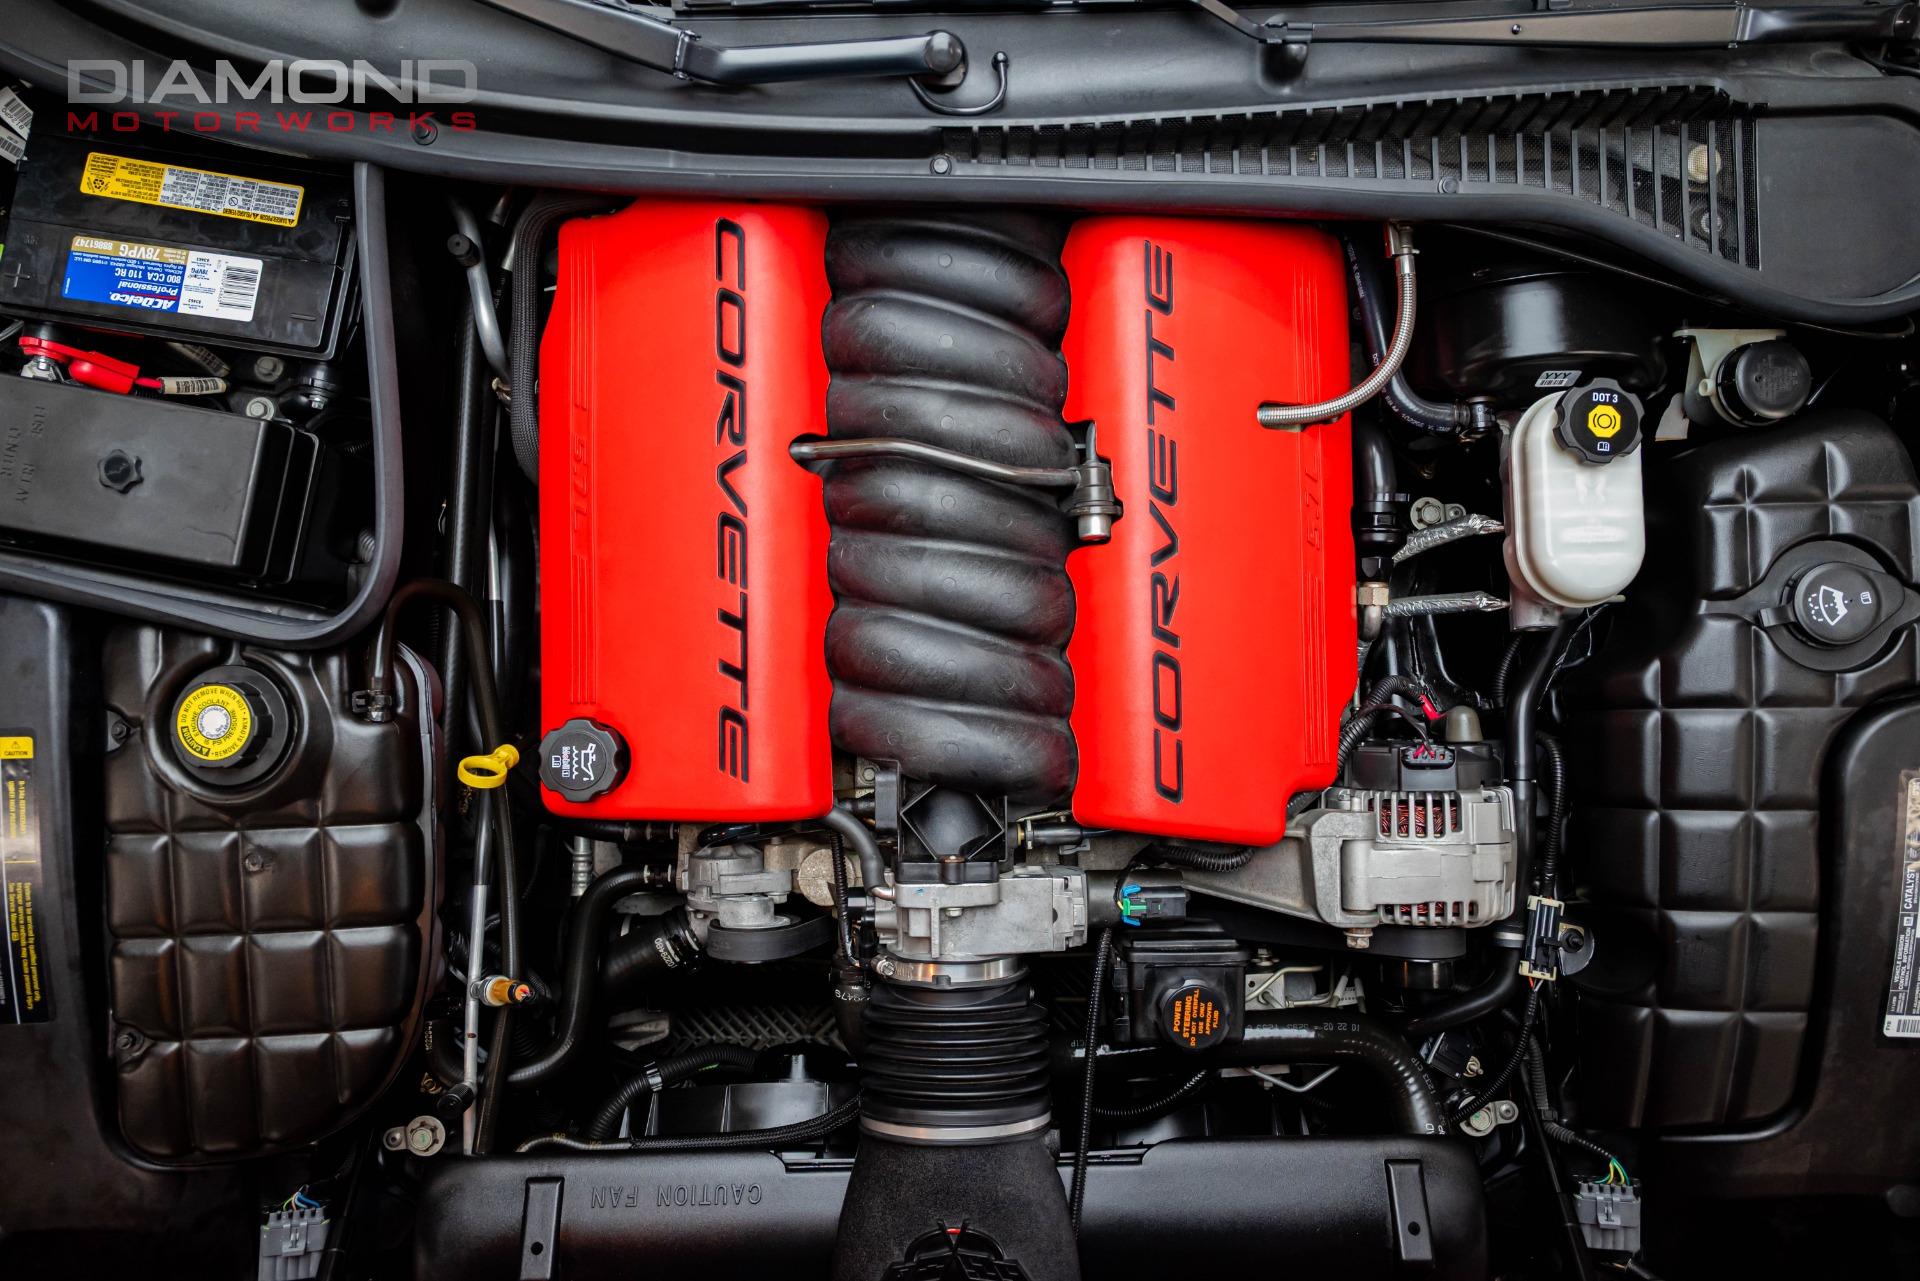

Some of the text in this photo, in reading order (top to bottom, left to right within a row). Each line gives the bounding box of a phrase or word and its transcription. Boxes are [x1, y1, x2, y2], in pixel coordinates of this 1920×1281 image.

[119, 244, 161, 260] 78VPG
[114, 267, 127, 278] RC
[128, 269, 142, 280] 110
[147, 271, 165, 283] CCA
[166, 274, 182, 284] 800
[118, 280, 179, 295] Professional
[109, 291, 176, 310] ACDelco
[1592, 392, 1618, 403] DOT 3
[716, 217, 749, 785] CORVETTE
[1143, 239, 1185, 805] CORVETTE
[181, 714, 188, 722] DO
[193, 688, 218, 700] REMOVE
[220, 689, 236, 700] WHEN
[236, 698, 246, 712] HOT
[198, 699, 229, 710] COOLANT
[182, 728, 201, 751] CAUTION
[214, 742, 238, 757] REMOVE
[1904, 868, 1915, 909] CATALYST
[28, 945, 37, 965] qualified
[1902, 928, 1911, 963] INFORMATION
[31, 966, 40, 990] personnel
[1894, 961, 1902, 982] VEHICLE
[1898, 965, 1907, 989] CONTROL
[24, 974, 32, 995] personal
[1173, 1001, 1182, 1032] POWER
[1183, 995, 1192, 1038] STEERING
[1323, 1022, 1333, 1030] 02
[1338, 1022, 1347, 1030] 22
[1190, 1037, 1196, 1046] DO
[589, 1183, 762, 1208] CAUTION FAN
